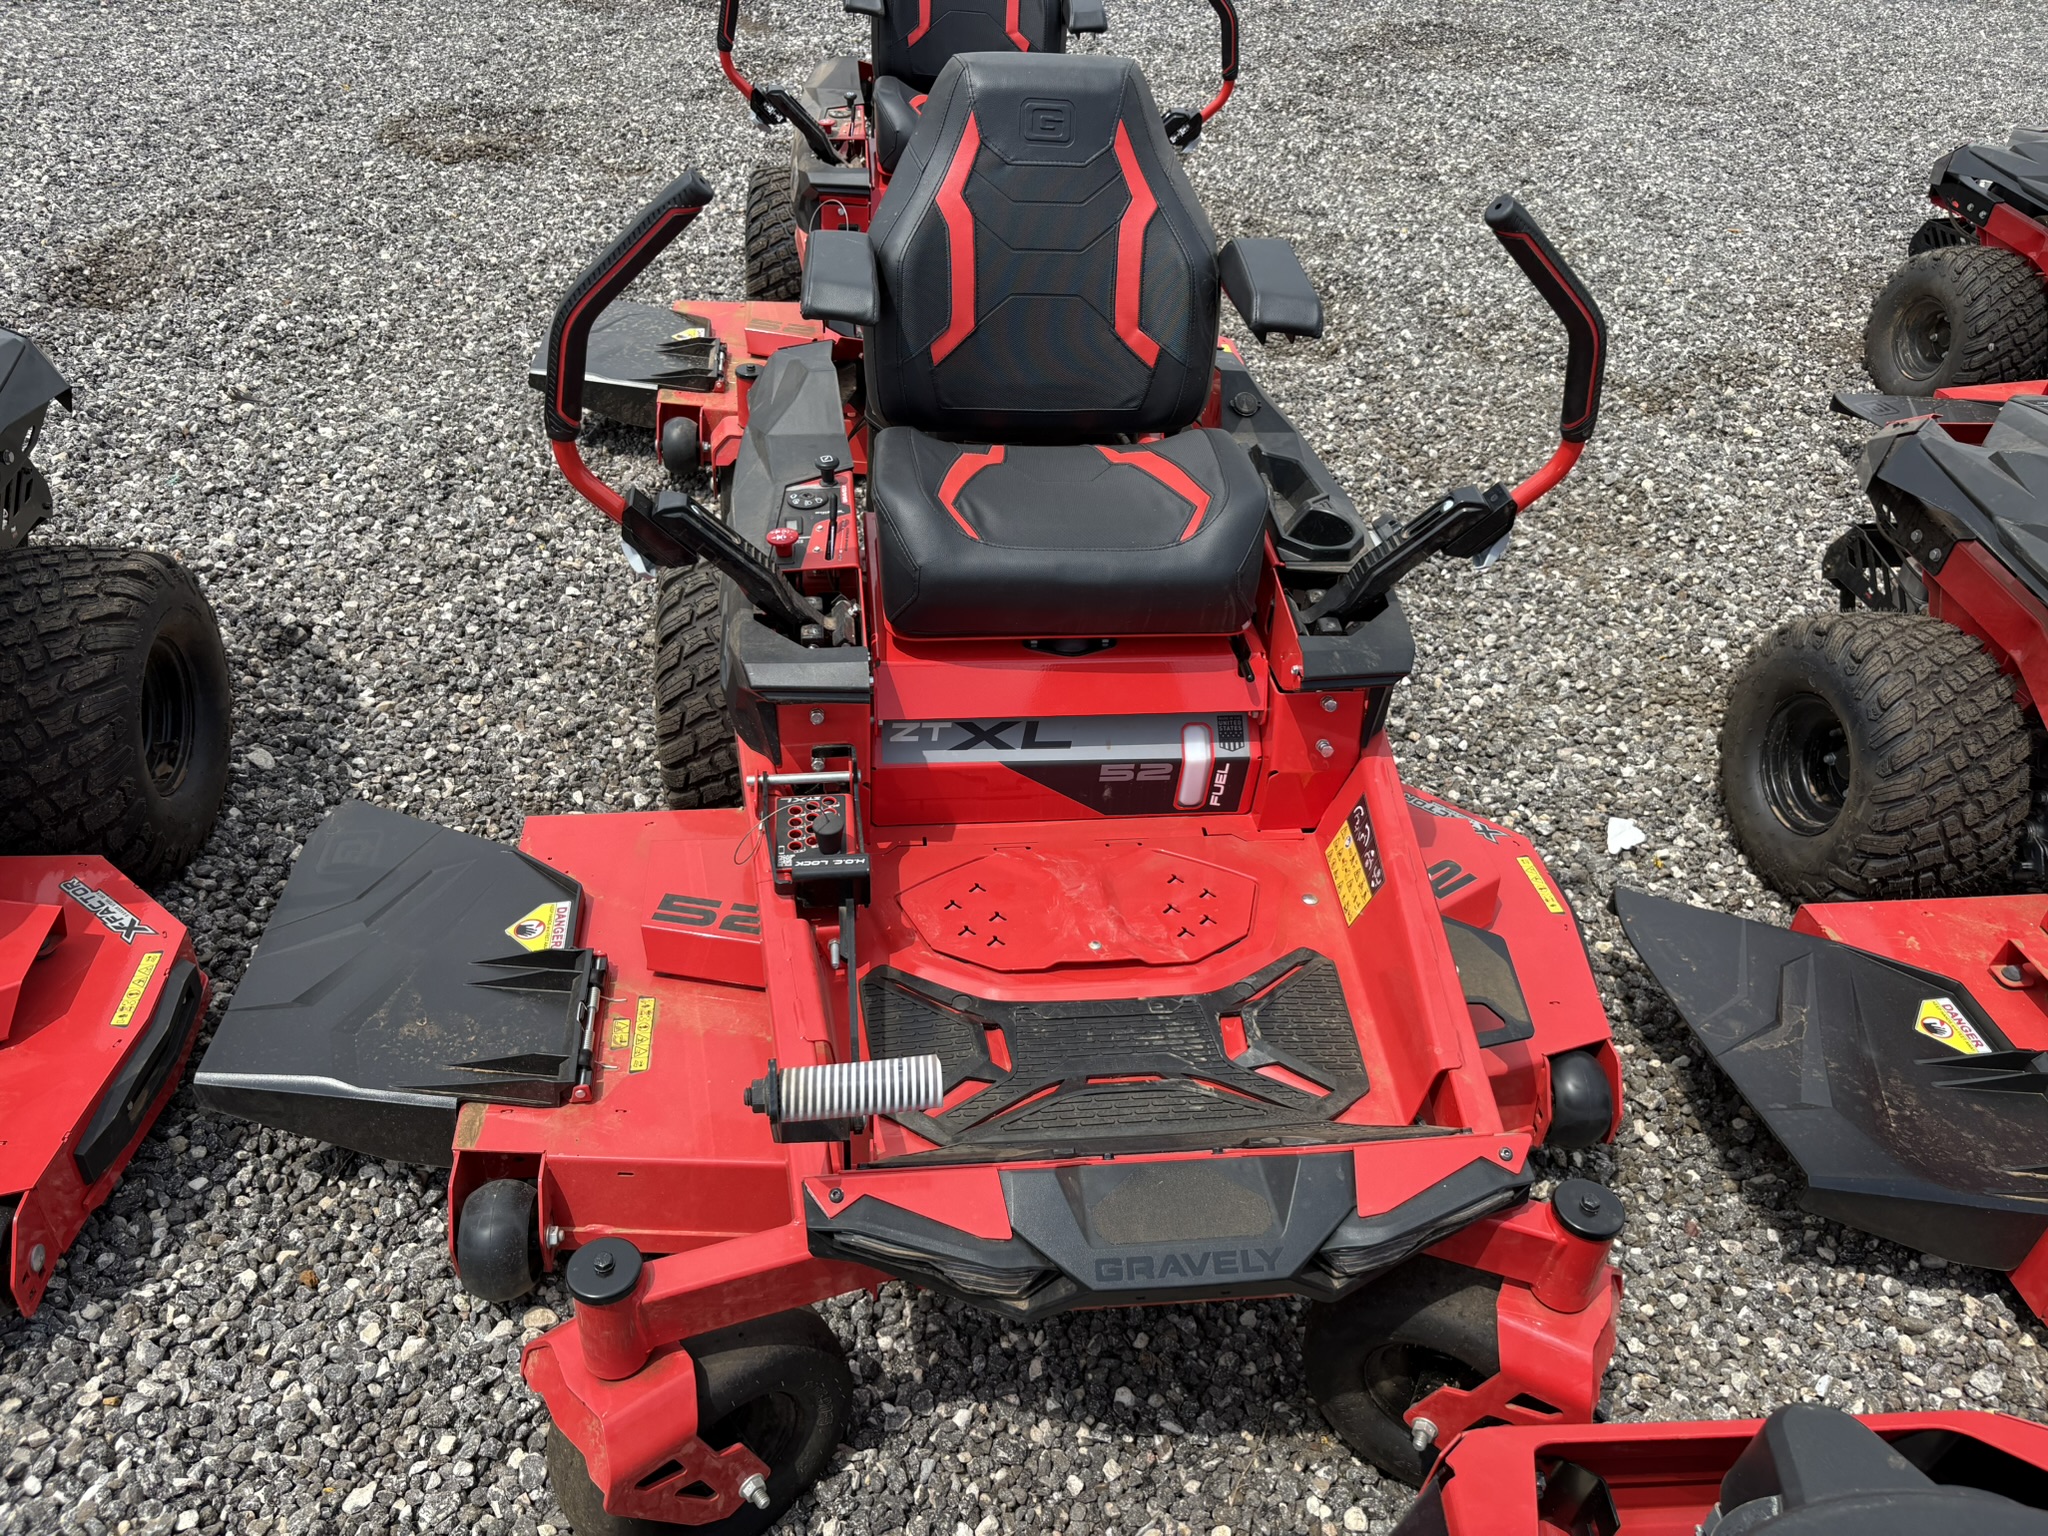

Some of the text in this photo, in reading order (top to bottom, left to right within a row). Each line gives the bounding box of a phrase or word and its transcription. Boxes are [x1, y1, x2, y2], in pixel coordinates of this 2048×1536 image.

[1099, 763, 1174, 783] 52
[1209, 763, 1231, 807] FUEL
[61, 877, 157, 943] X-FACTOR
[550, 906, 568, 950] DANGER
[651, 892, 761, 936] 52
[1941, 1003, 1984, 1048] DANGER
[1095, 1246, 1284, 1282] GRAVELY
